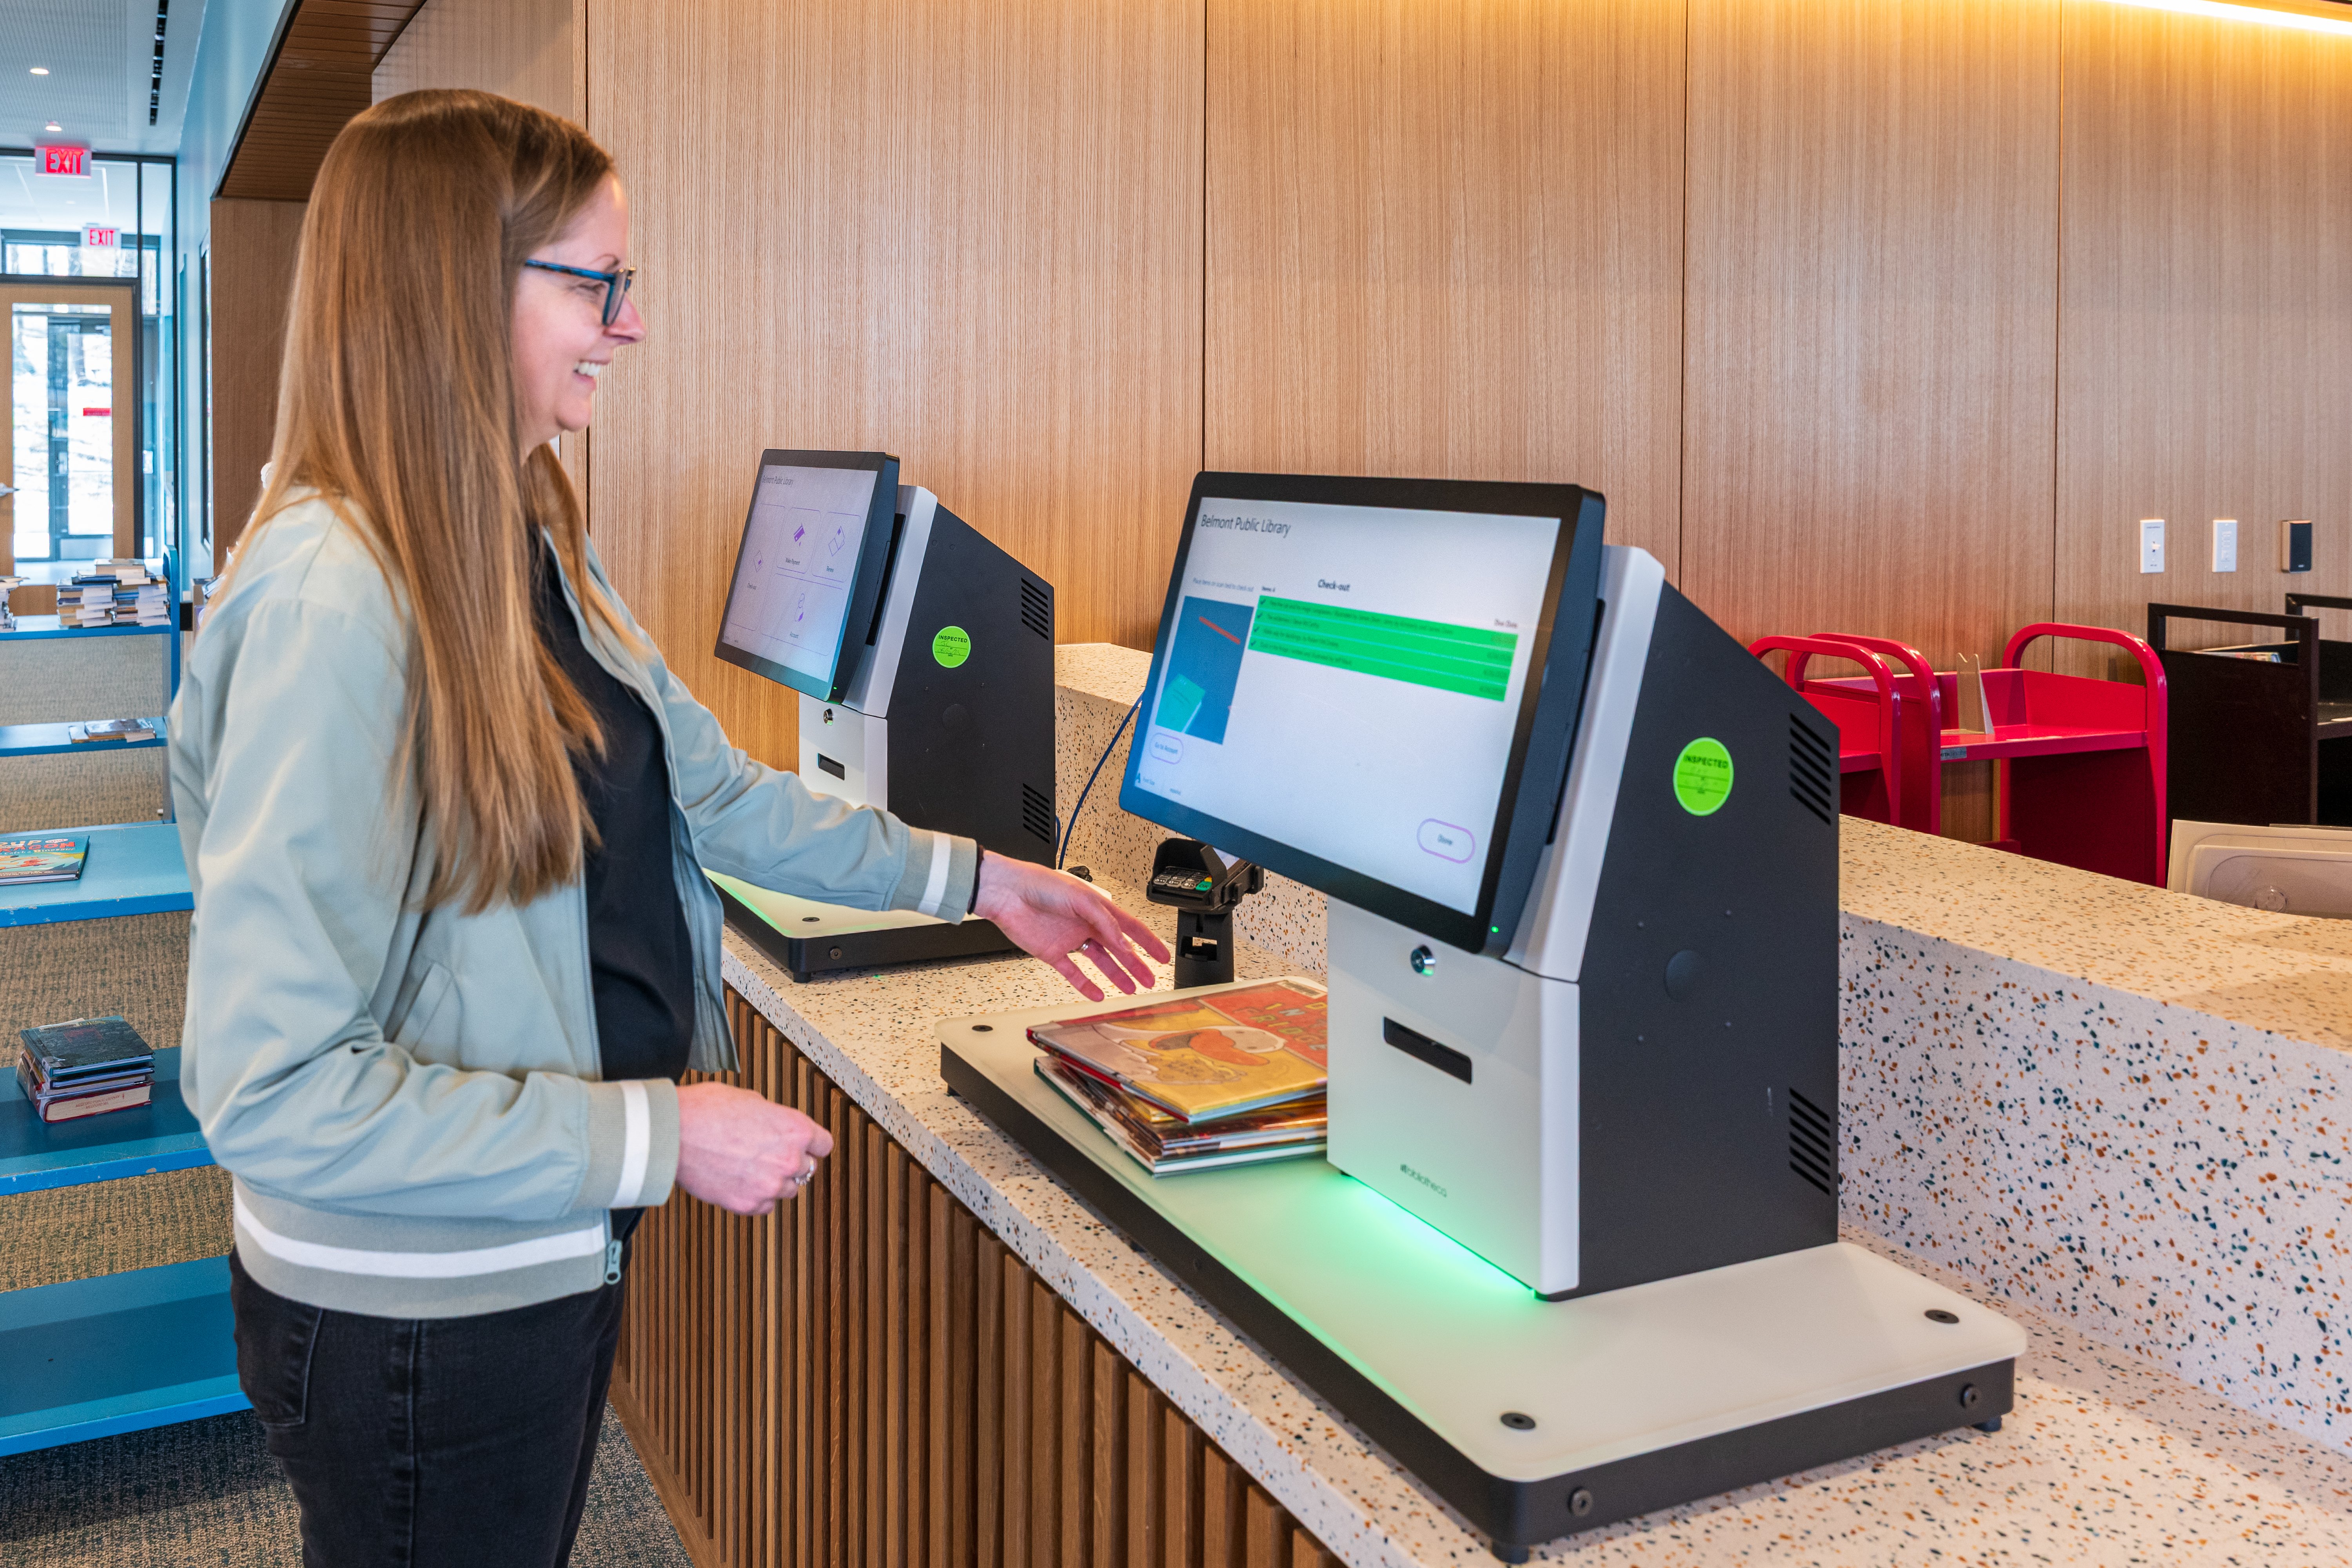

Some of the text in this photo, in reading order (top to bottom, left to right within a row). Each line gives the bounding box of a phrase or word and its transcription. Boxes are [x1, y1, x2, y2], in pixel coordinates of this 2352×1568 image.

[45, 149, 84, 174] EXIT
[89, 229, 115, 246] EXIT
[1201, 514, 1291, 539] Belmont Public Library
[1318, 578, 1350, 592] Check-out
[938, 635, 967, 643] INSPECTED
[1684, 754, 1729, 769] INSPECTED
